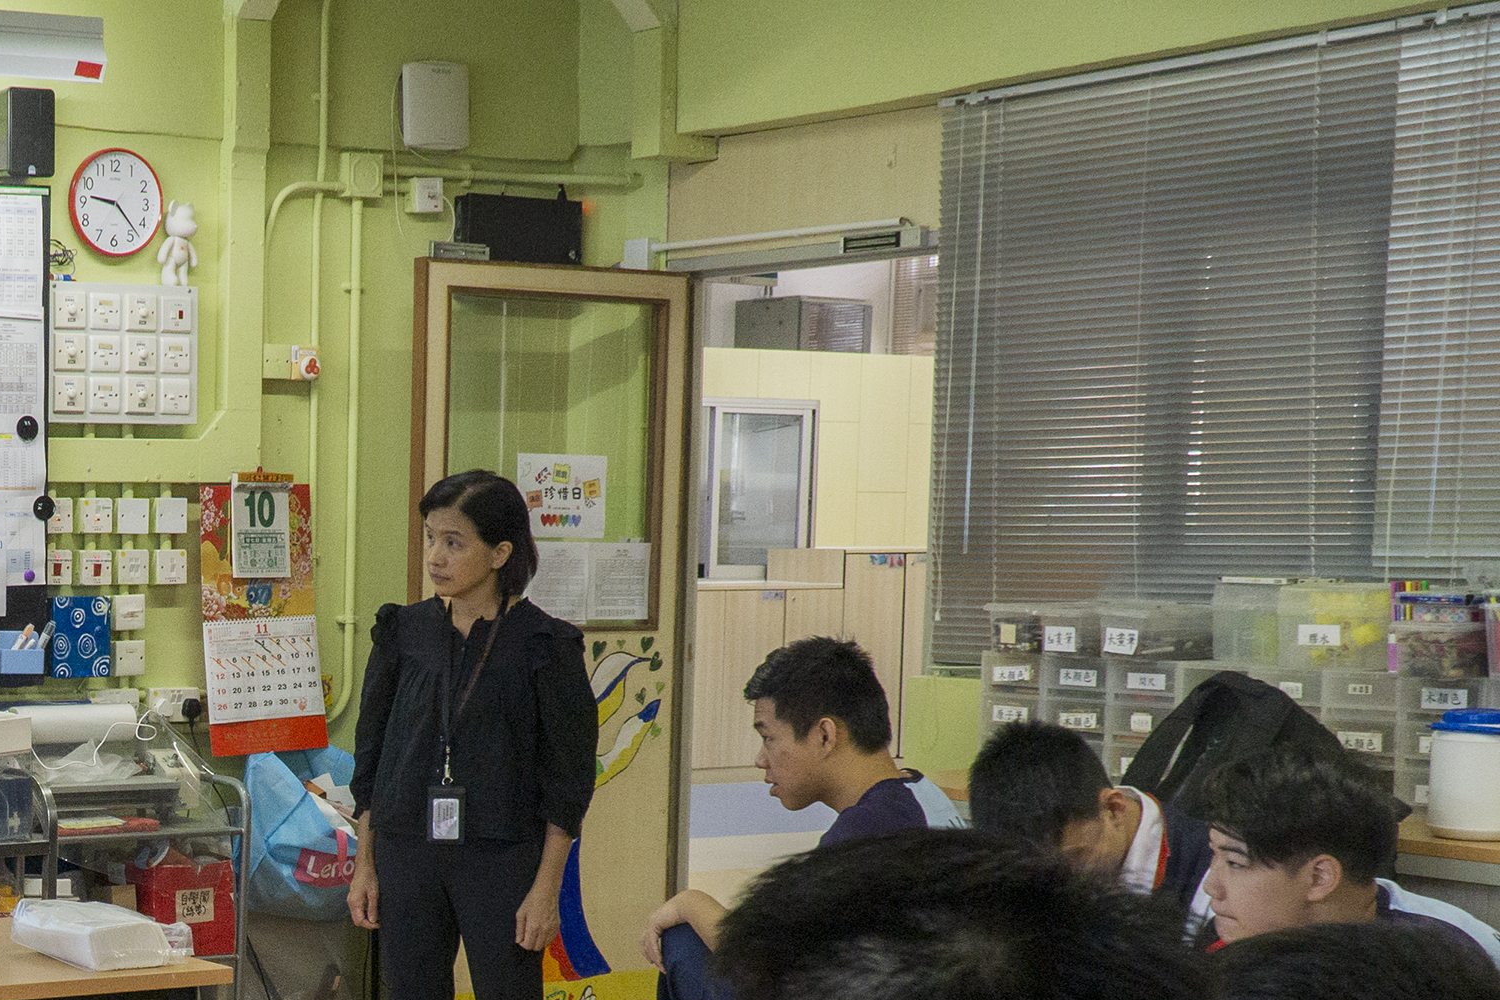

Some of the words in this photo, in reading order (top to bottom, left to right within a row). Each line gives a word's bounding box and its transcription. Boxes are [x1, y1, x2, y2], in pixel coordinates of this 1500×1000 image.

[96, 164, 105, 177] 11
[110, 159, 121, 172] 12
[130, 165, 133, 178] 1
[82, 177, 94, 191] 10
[140, 180, 148, 193] 2
[80, 195, 87, 209] 9
[142, 198, 150, 212] 3
[81, 213, 90, 227] 8
[139, 216, 146, 229] 4
[95, 229, 103, 242] 7
[110, 234, 118, 248] 6
[126, 229, 135, 243] 5
[244, 490, 275, 528] 10
[256, 623, 268, 634] 11
